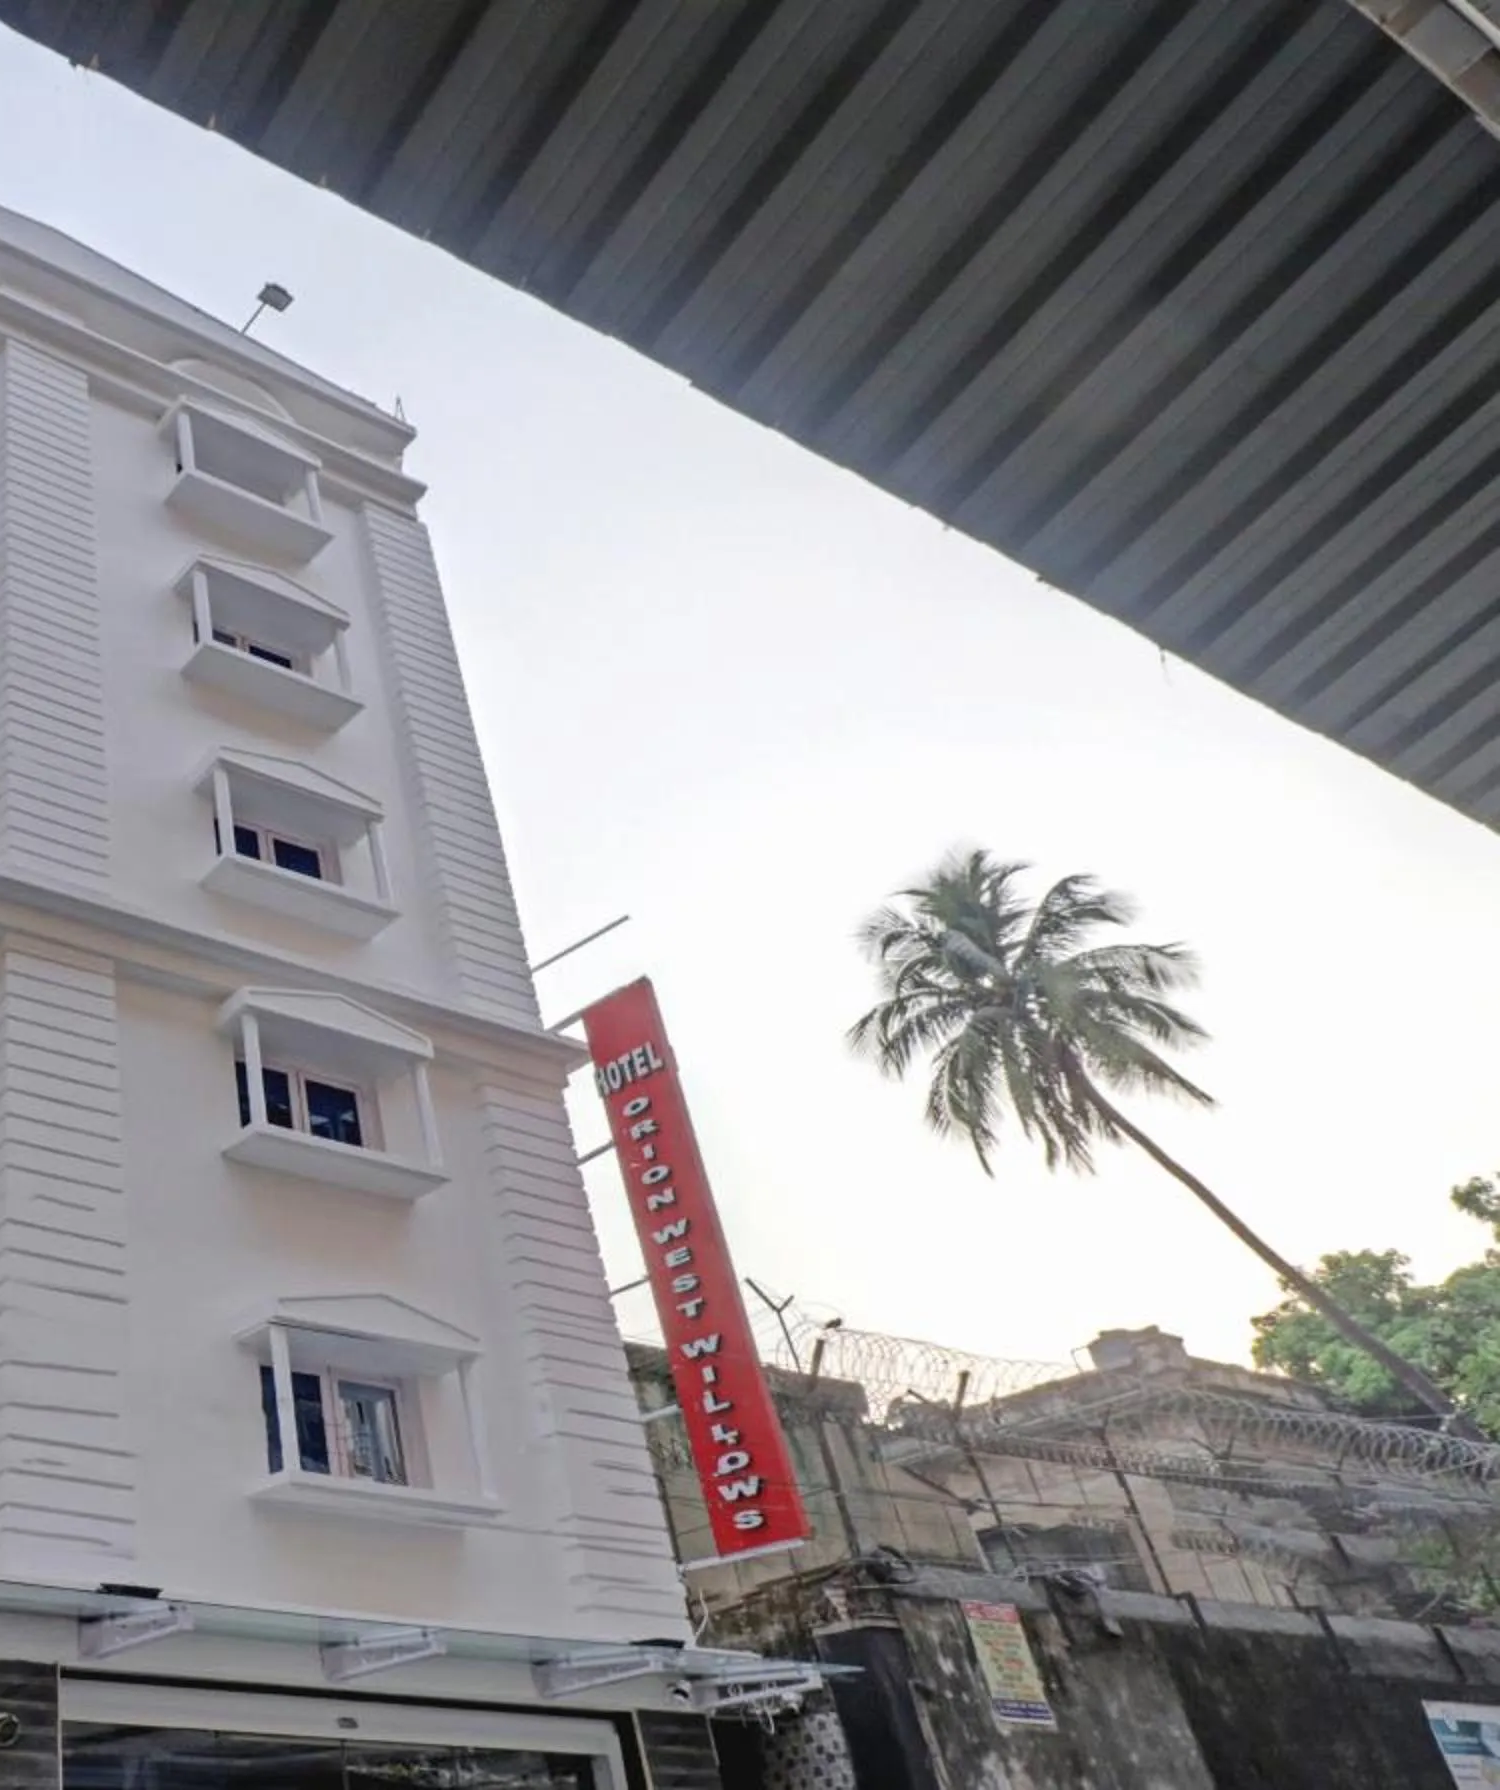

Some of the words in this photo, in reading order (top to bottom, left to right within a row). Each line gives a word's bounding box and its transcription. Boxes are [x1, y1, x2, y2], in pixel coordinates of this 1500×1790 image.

[594, 1041, 663, 1097] HOTEL
[623, 1096, 677, 1211] ORION
[653, 1217, 704, 1318] WEST
